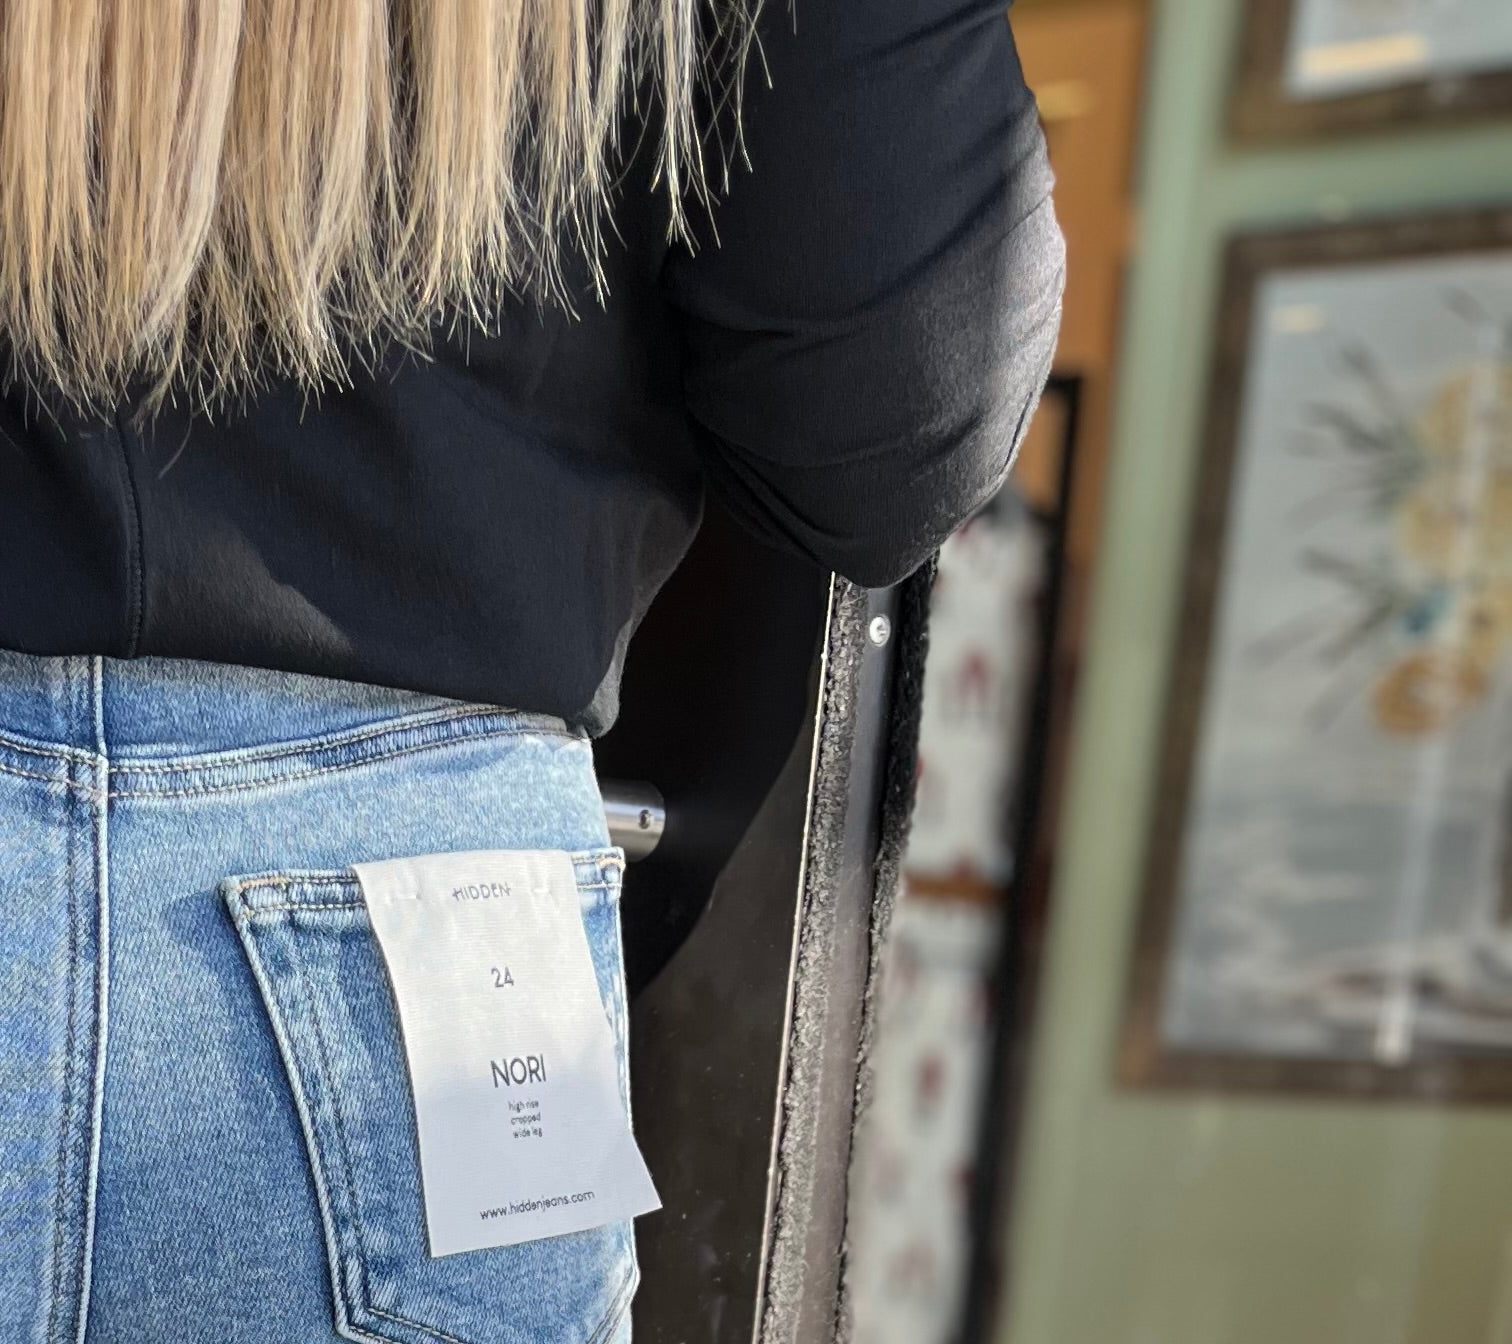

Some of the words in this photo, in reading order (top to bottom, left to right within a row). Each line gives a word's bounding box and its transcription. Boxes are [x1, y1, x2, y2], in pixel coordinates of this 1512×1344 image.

[452, 883, 511, 901] HIDDEN
[491, 966, 514, 988] 24
[490, 1053, 546, 1088] NORI
[510, 1112, 541, 1126] cropped
[479, 1191, 595, 1220] www.hiddenjeans.com
